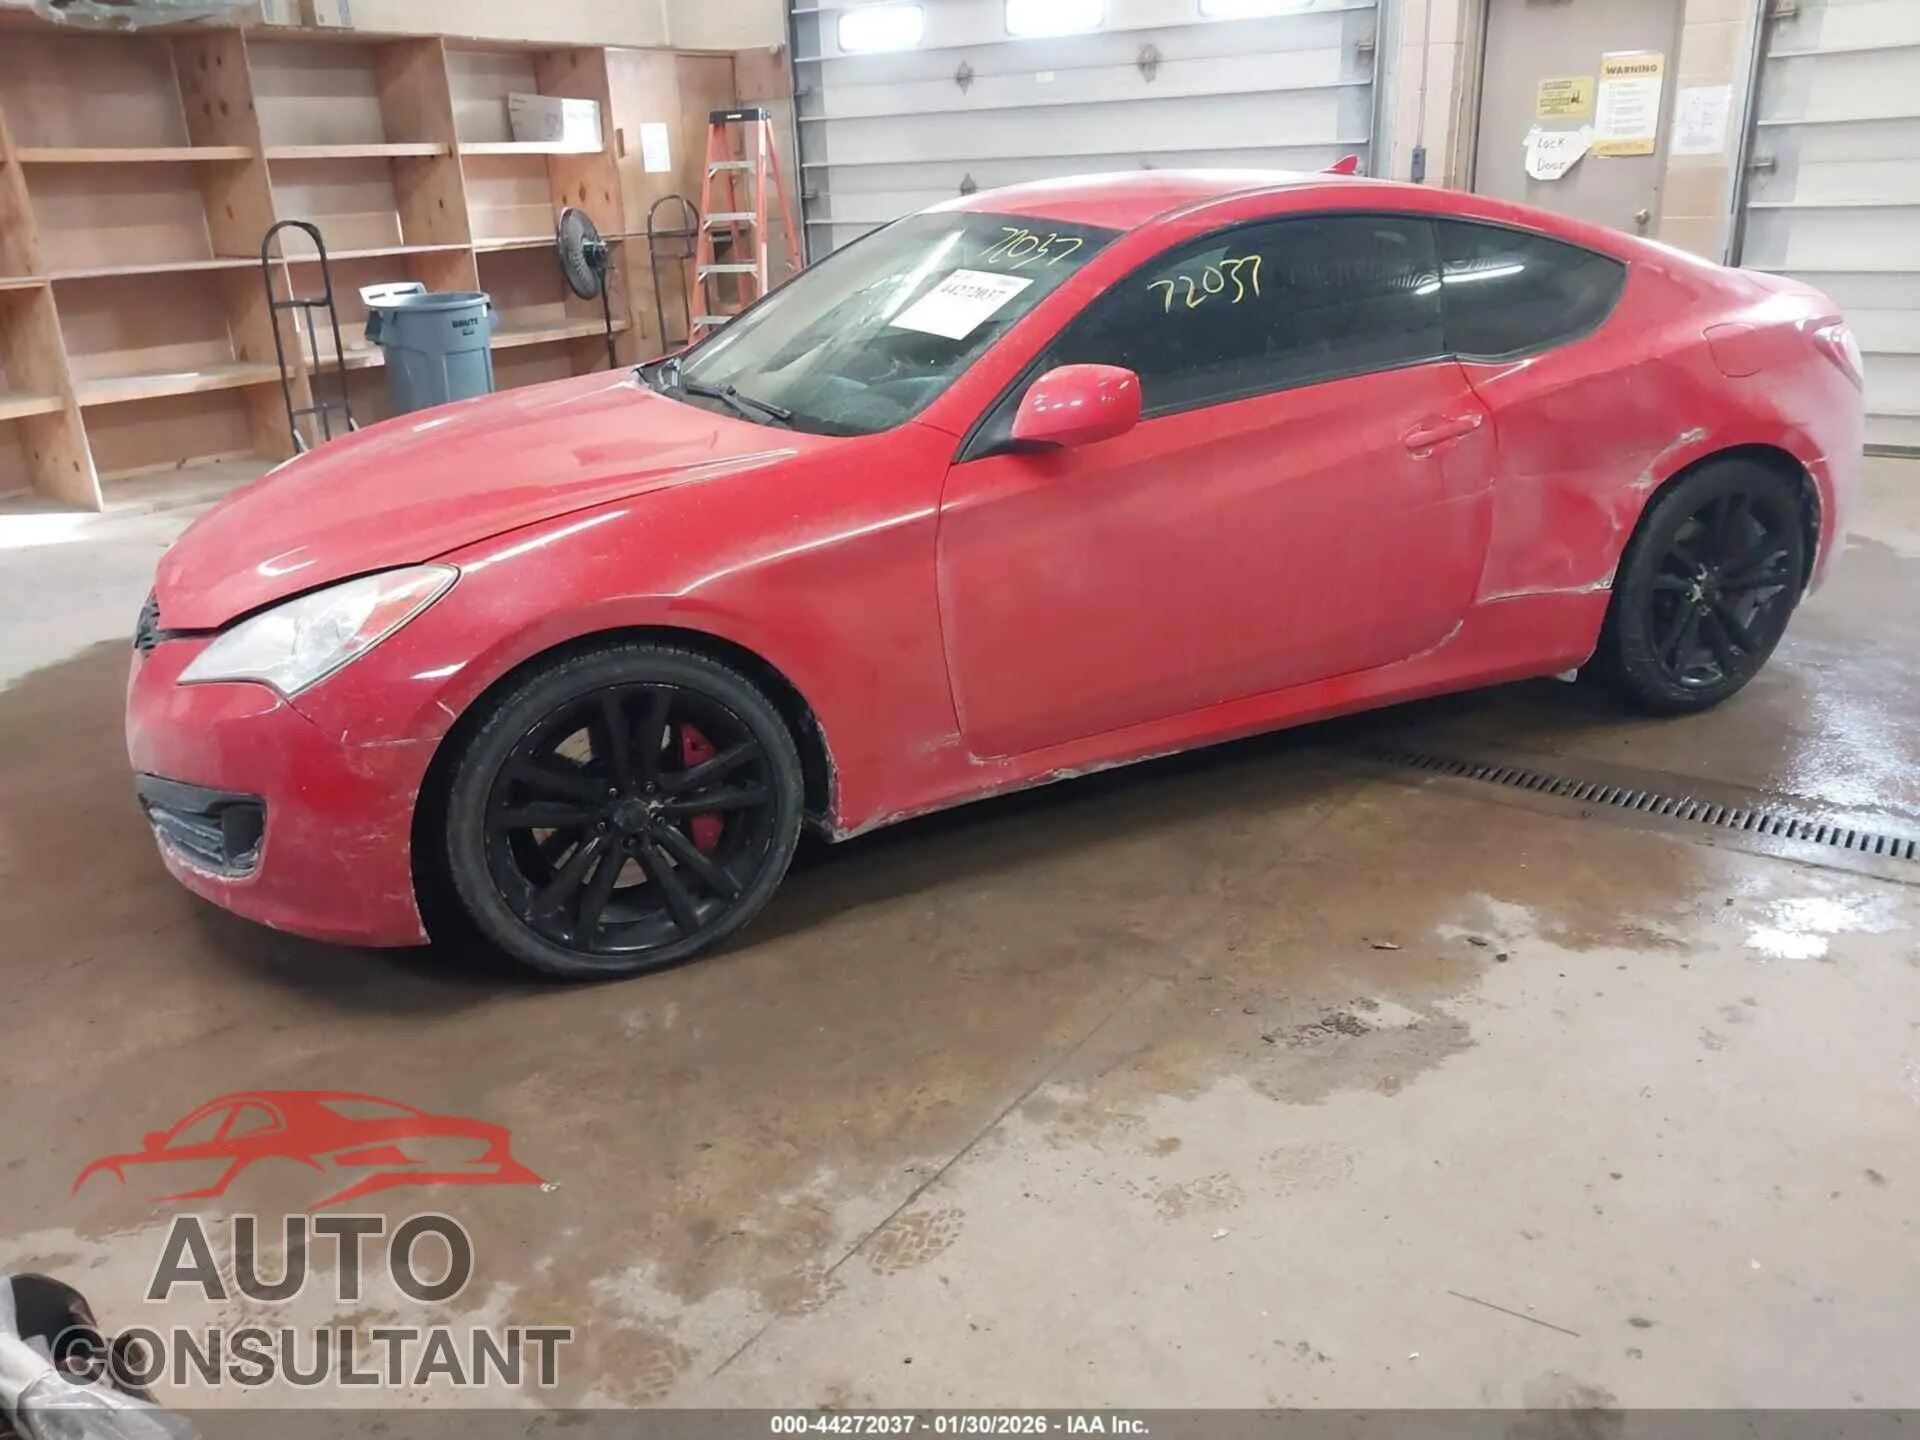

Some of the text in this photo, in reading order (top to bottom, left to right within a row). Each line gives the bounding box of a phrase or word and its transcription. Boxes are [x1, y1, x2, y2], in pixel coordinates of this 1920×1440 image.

[1606, 64, 1658, 75] WARNING
[978, 226, 1083, 270] 72037
[1146, 254, 1262, 313] 72037
